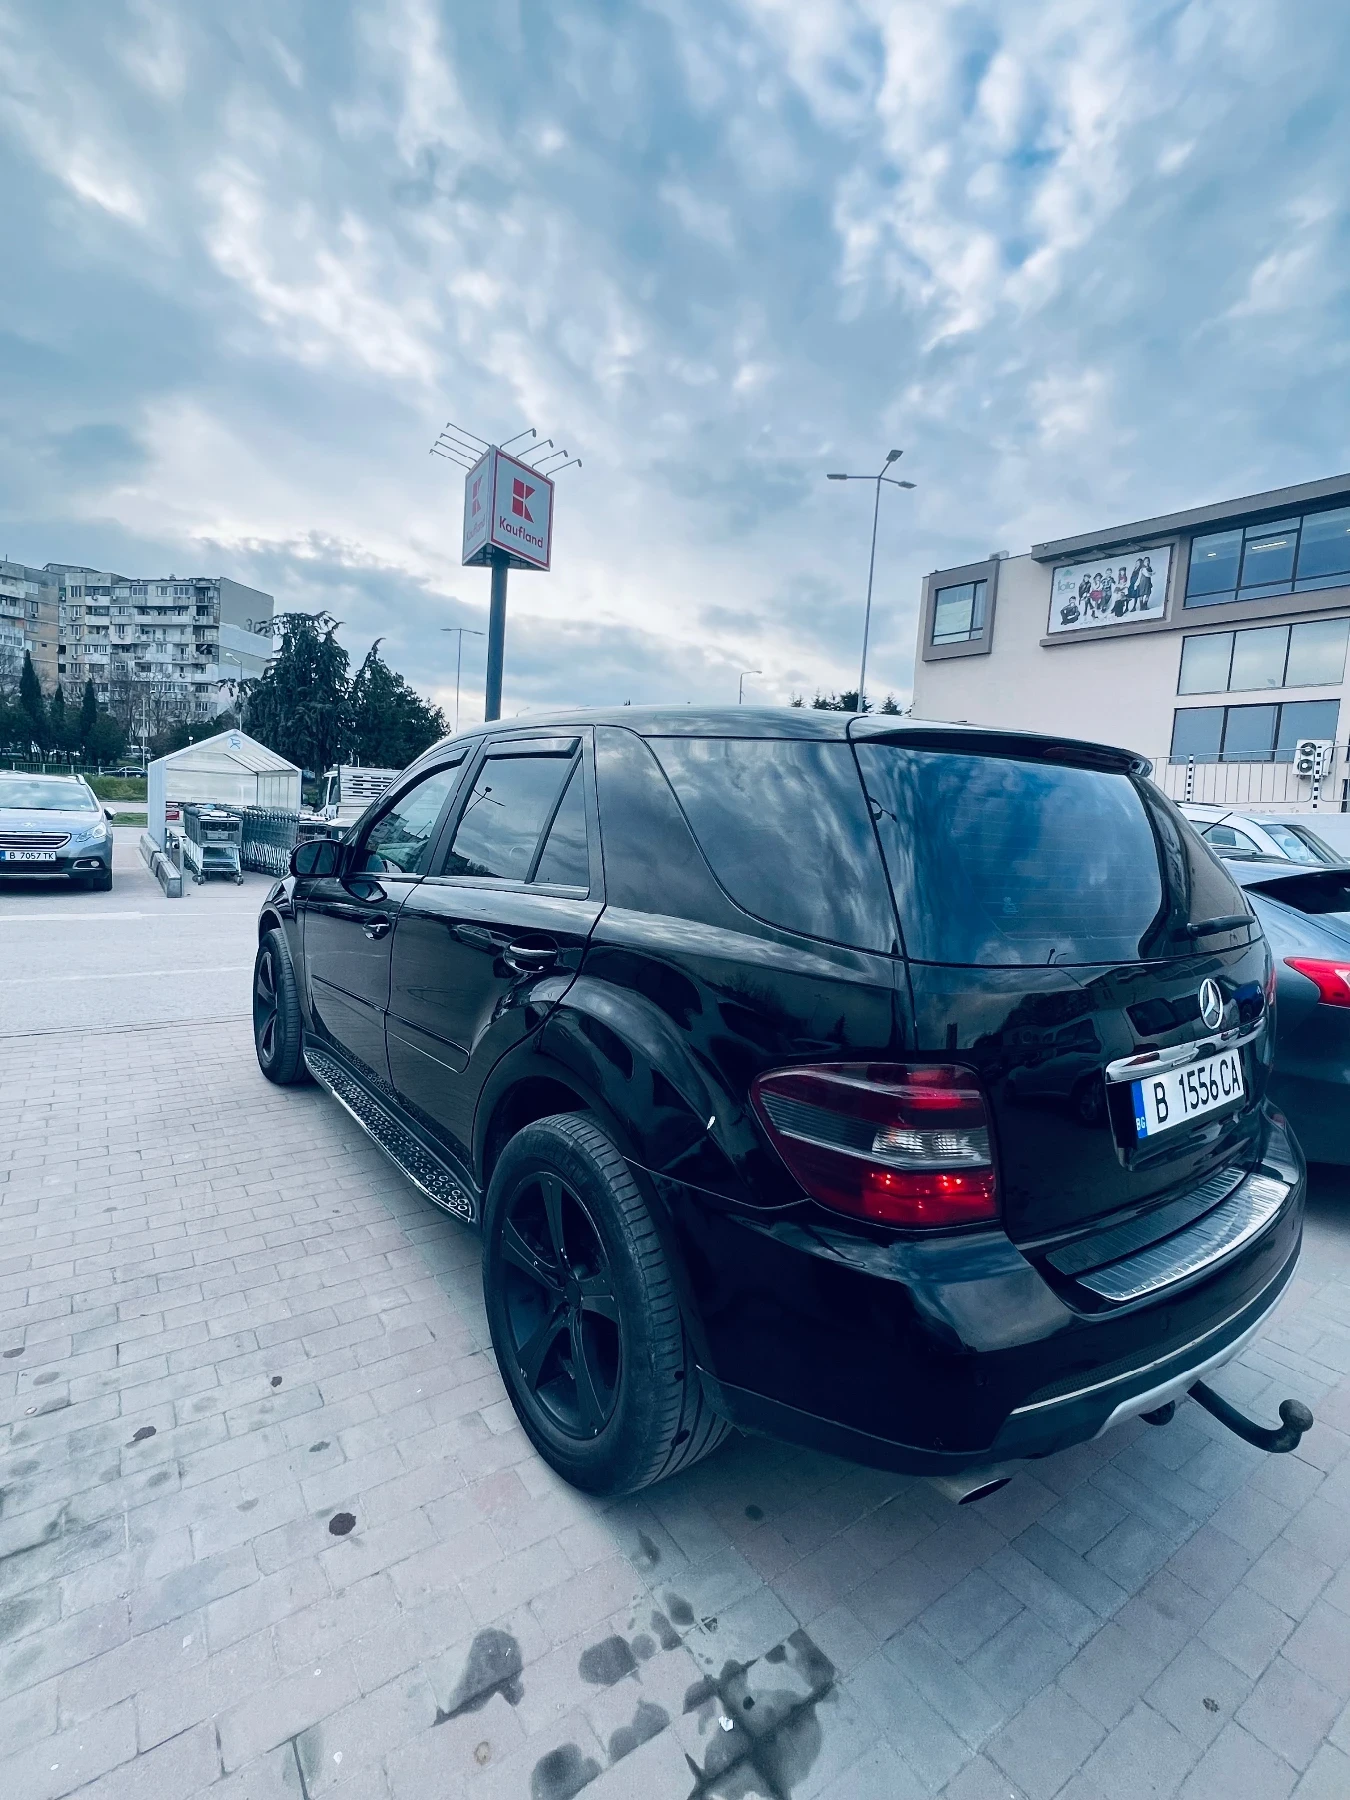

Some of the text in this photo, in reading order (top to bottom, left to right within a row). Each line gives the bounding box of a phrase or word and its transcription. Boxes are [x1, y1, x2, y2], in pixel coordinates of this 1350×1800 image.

[499, 516, 544, 548] Kaufland
[1153, 1055, 1241, 1124] B 1556 CA
[1135, 1116, 1146, 1131] BG
